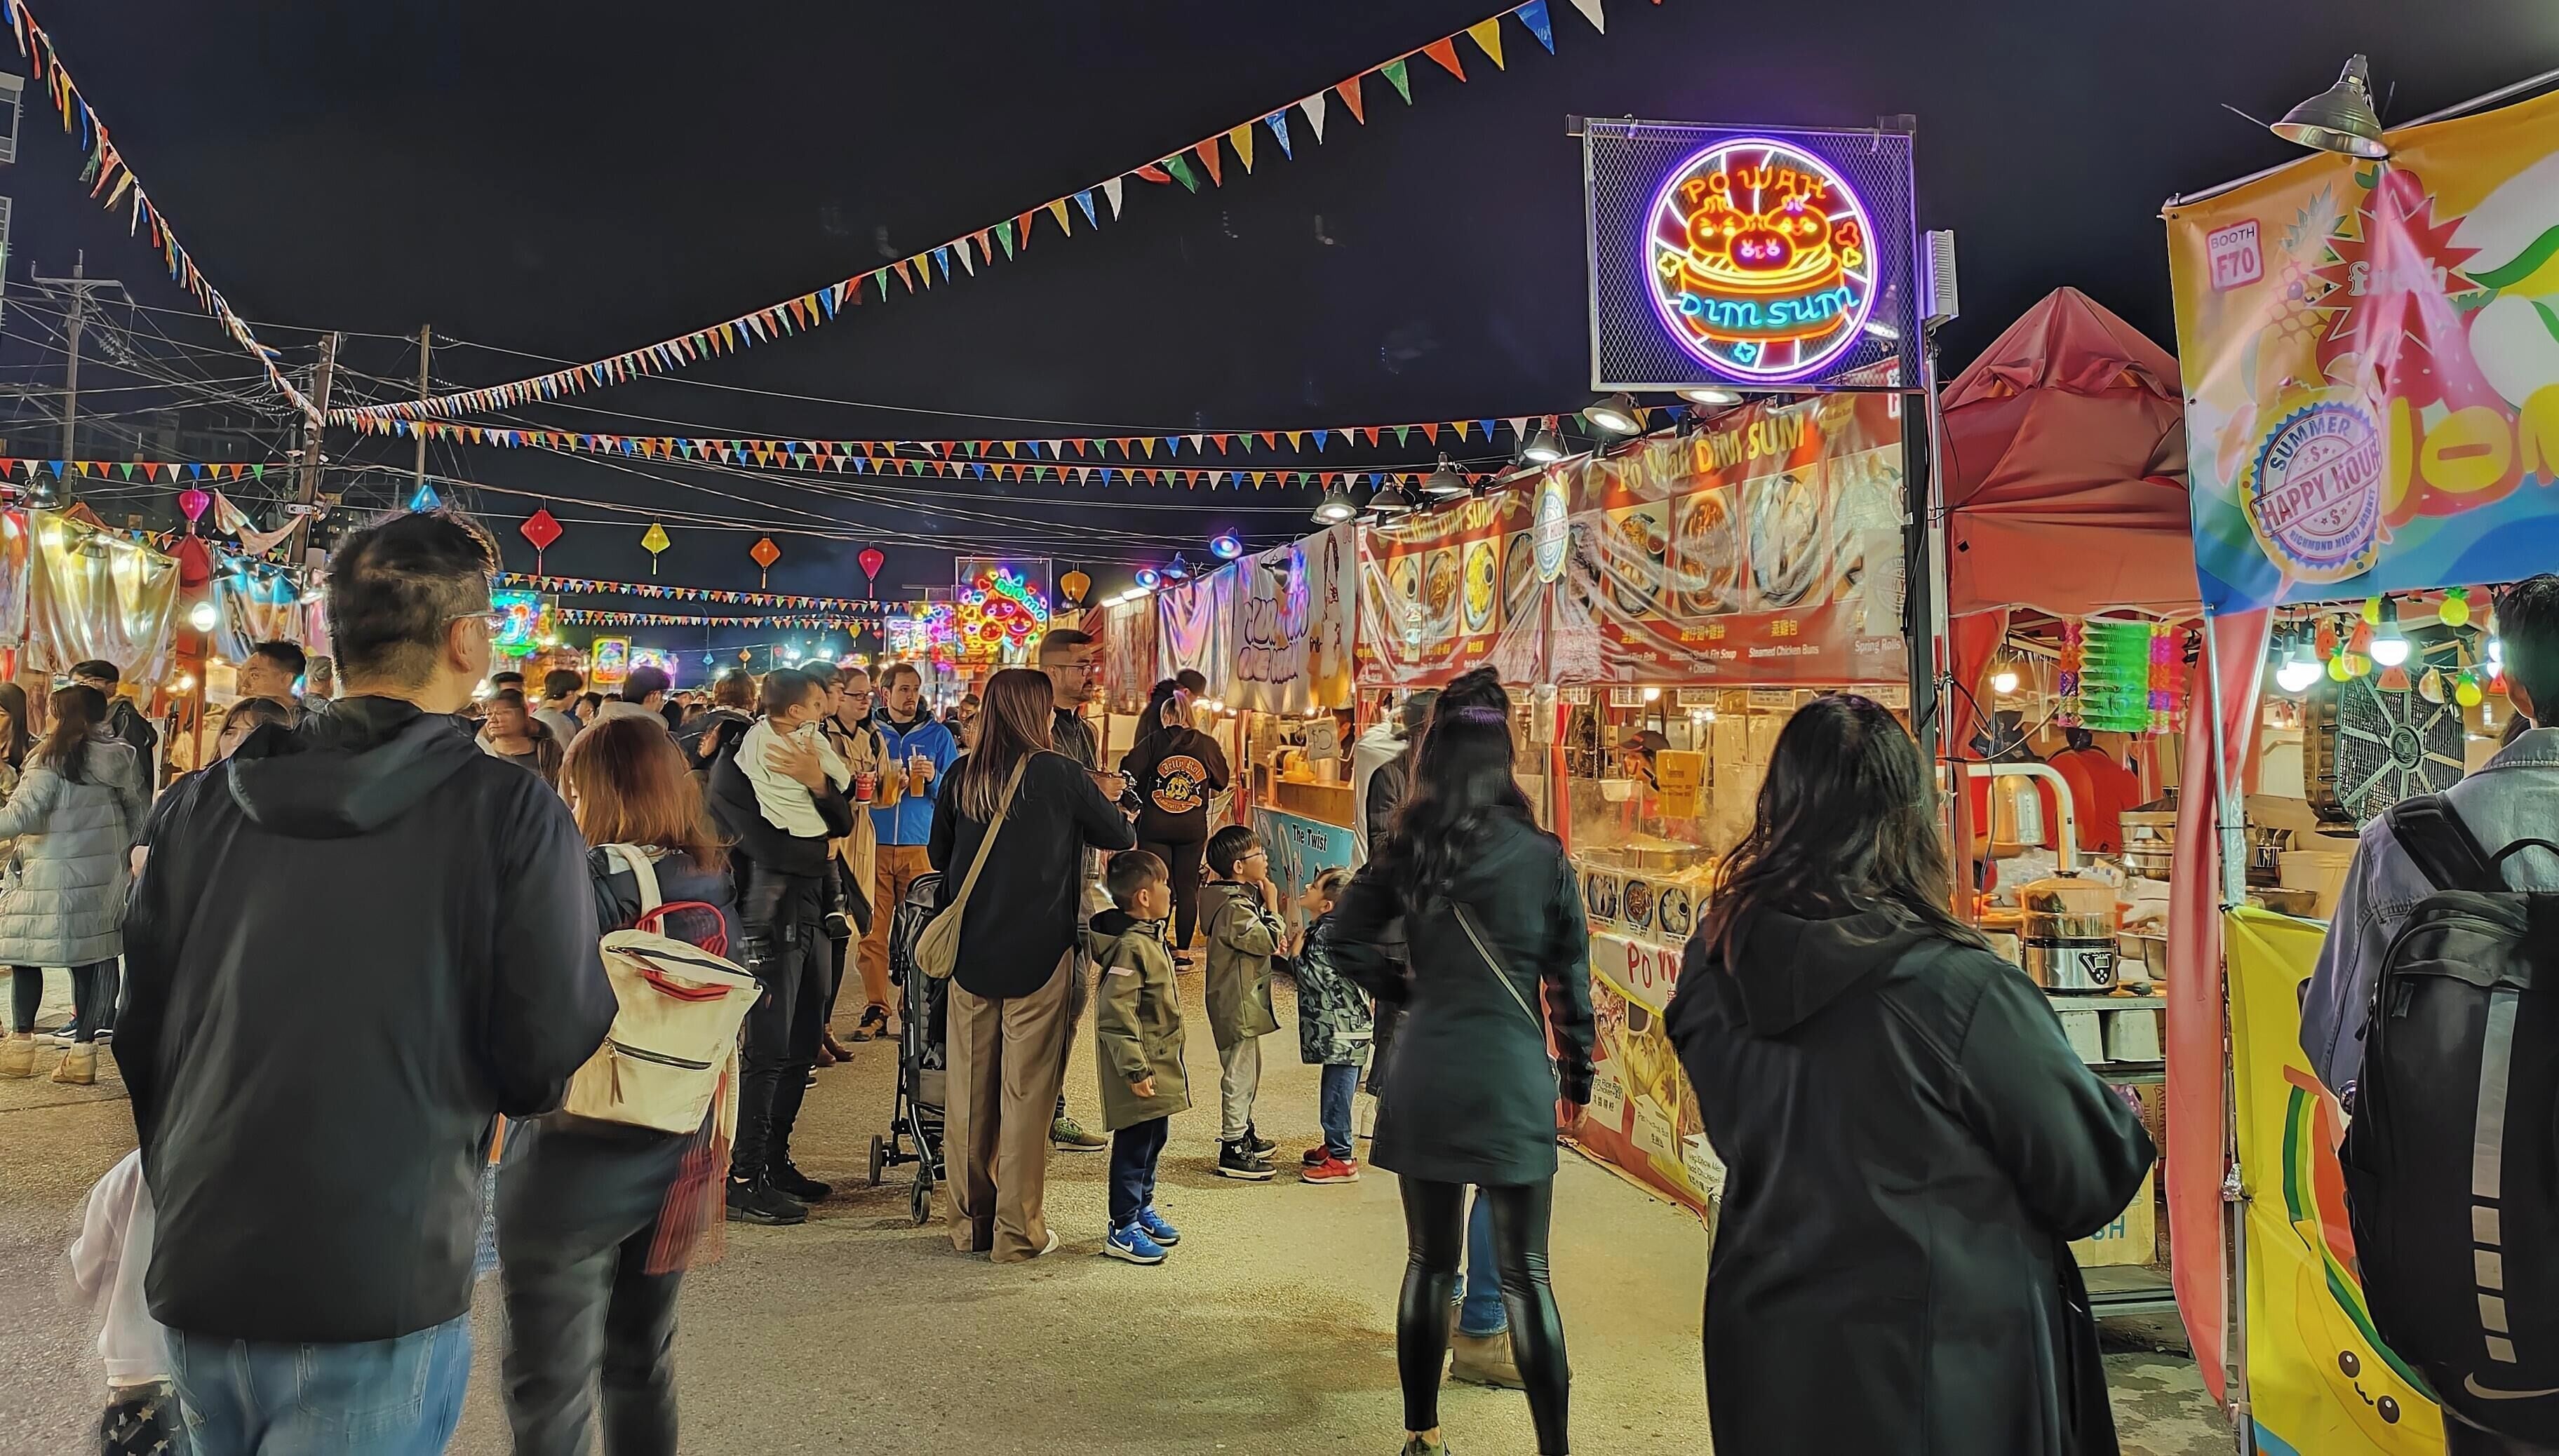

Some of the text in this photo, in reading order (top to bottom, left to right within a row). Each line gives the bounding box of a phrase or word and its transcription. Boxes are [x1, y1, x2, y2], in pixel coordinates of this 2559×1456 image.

[1681, 165, 1827, 204] PO WAH
[2210, 226, 2255, 250] BOOTH
[2216, 246, 2255, 283] F70
[1766, 285, 1860, 326] SUM
[1748, 412, 1805, 460] SUM
[2269, 415, 2350, 472] SUMMER
[2260, 471, 2328, 530] HAPPY
[2330, 436, 2381, 494] HOUR
[1466, 500, 1495, 531] SUM
[2289, 488, 2376, 551] RICHMOND NIGHT MARKET
[994, 578, 1048, 622] momo
[1710, 649, 1719, 659] Fin
[1719, 648, 1738, 661] Soup
[1747, 643, 1820, 658] Steamed Chicken Buns
[1854, 638, 1901, 655] Spring Rolls
[1310, 724, 1334, 751] $5
[1292, 823, 1328, 852] The Twist
